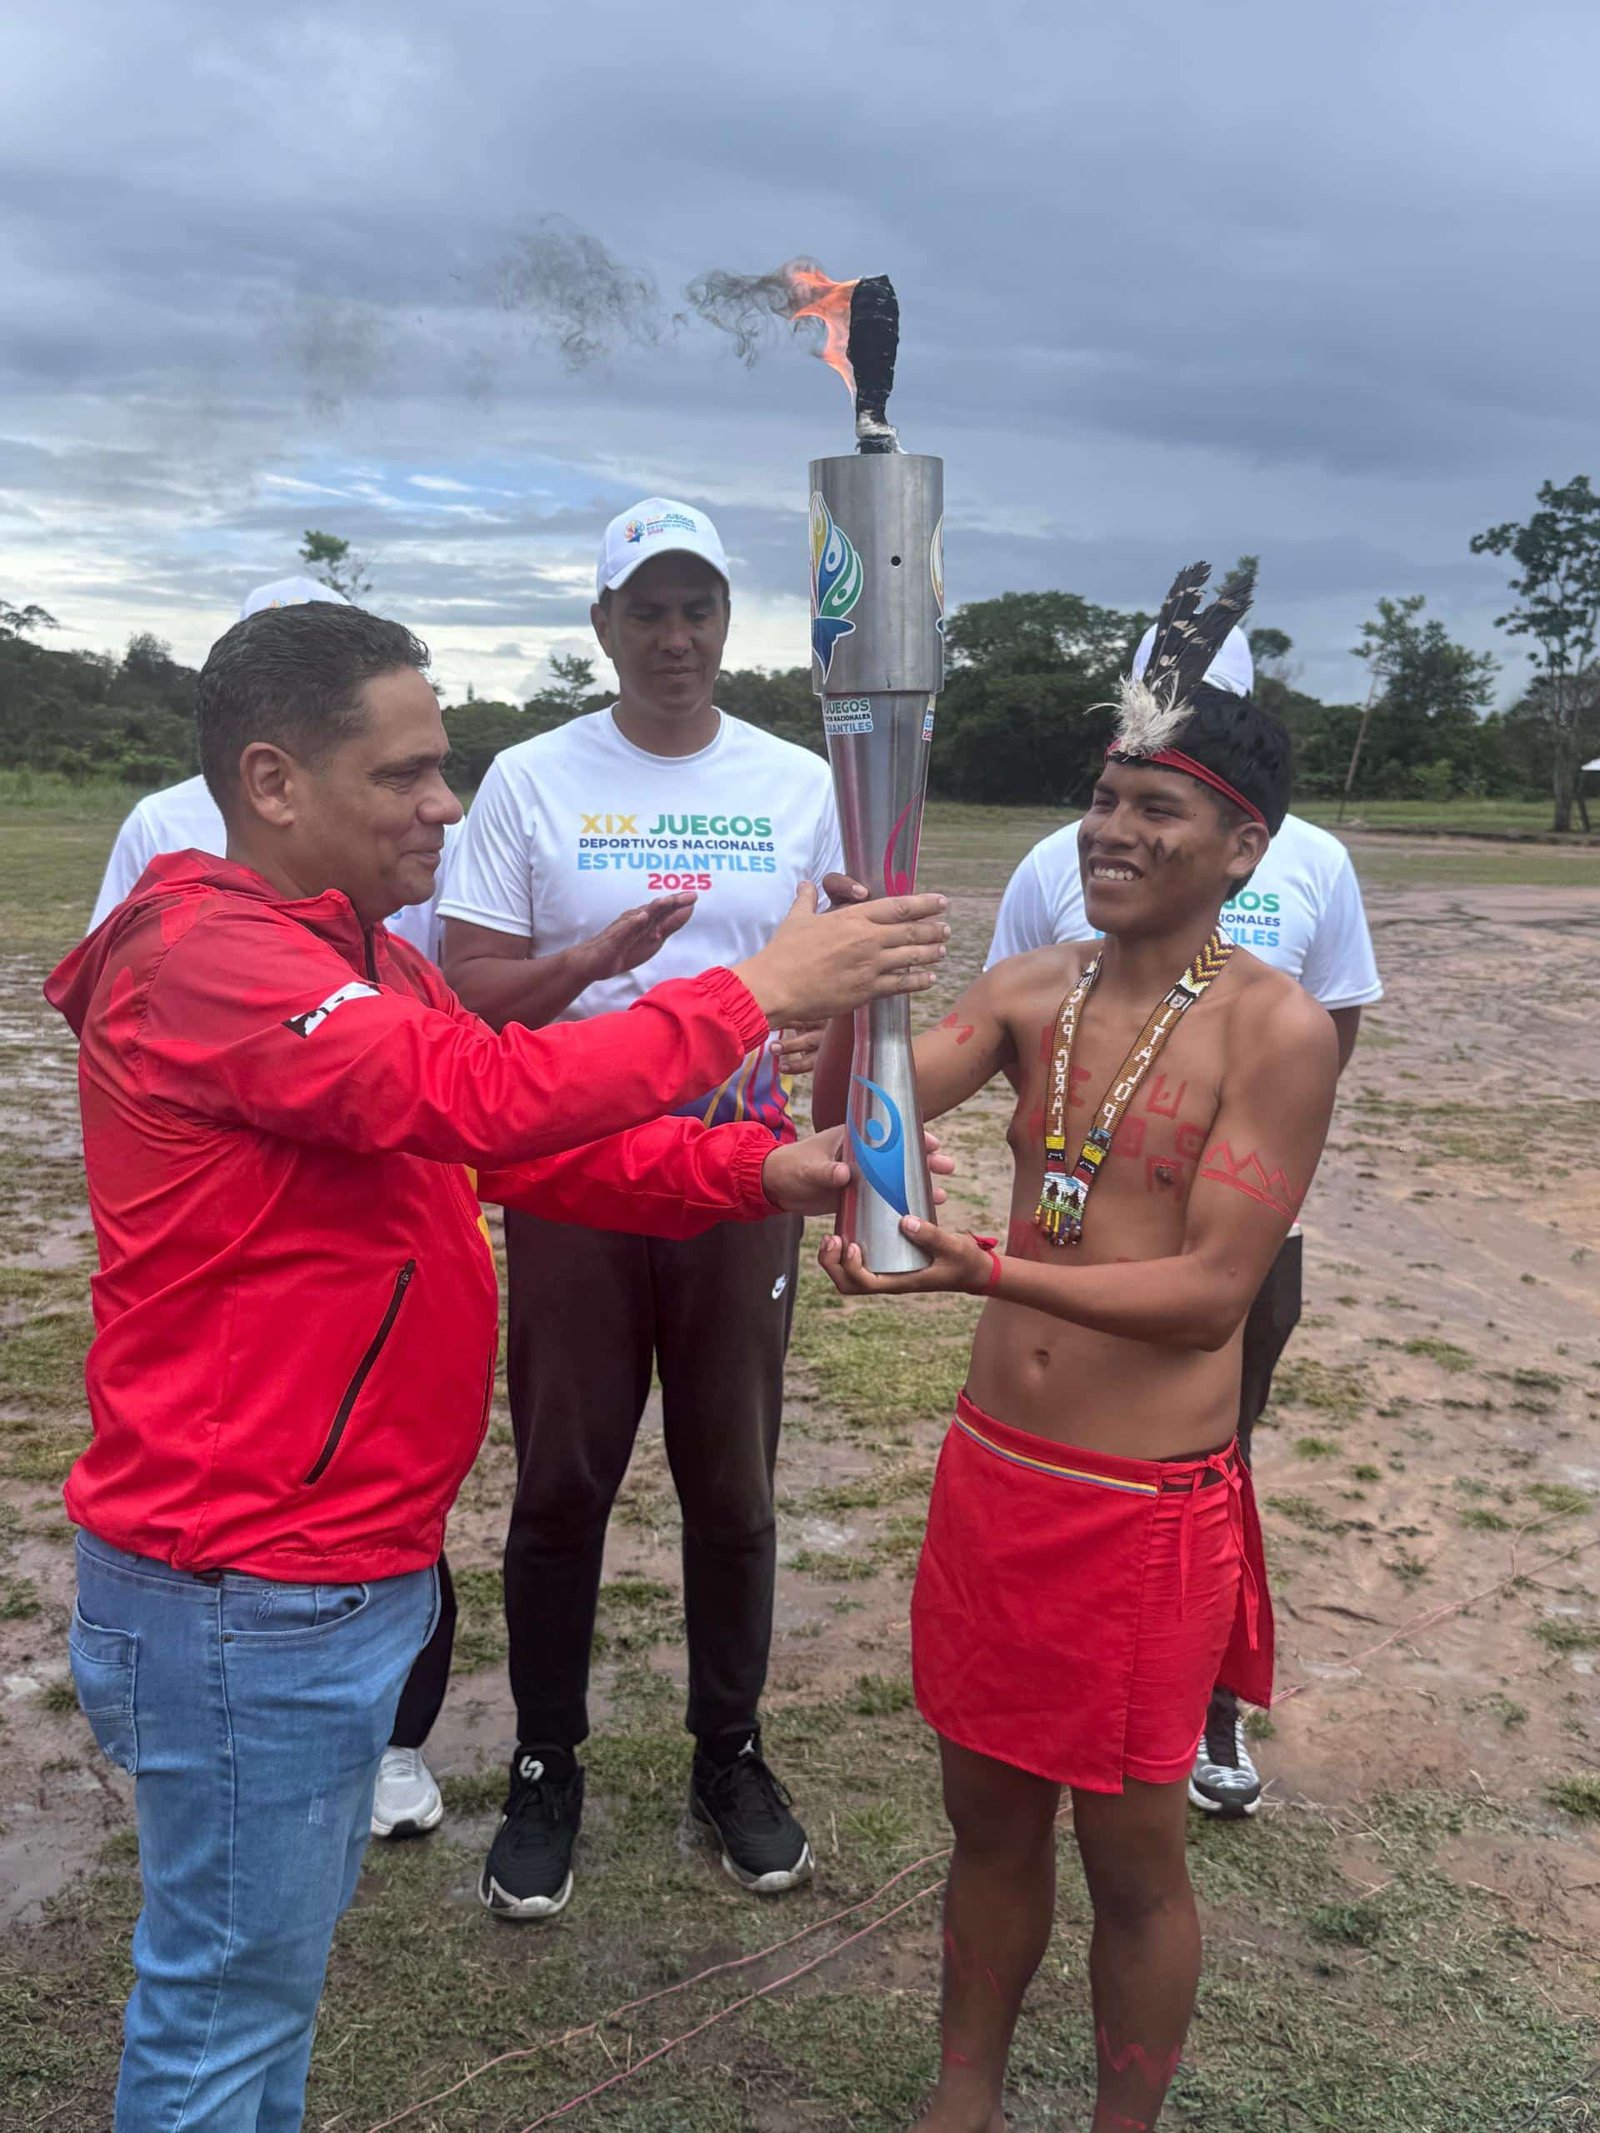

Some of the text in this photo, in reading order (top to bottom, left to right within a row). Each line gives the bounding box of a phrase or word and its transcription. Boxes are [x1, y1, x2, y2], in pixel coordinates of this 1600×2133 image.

[580, 814, 772, 837] XIX JUEGOS
[579, 838, 774, 851] DEPORTIVOS NACIONALES
[577, 852, 777, 873] ESTUDIANTILES
[647, 873, 712, 891] 2025
[1221, 914, 1280, 927] IONALES
